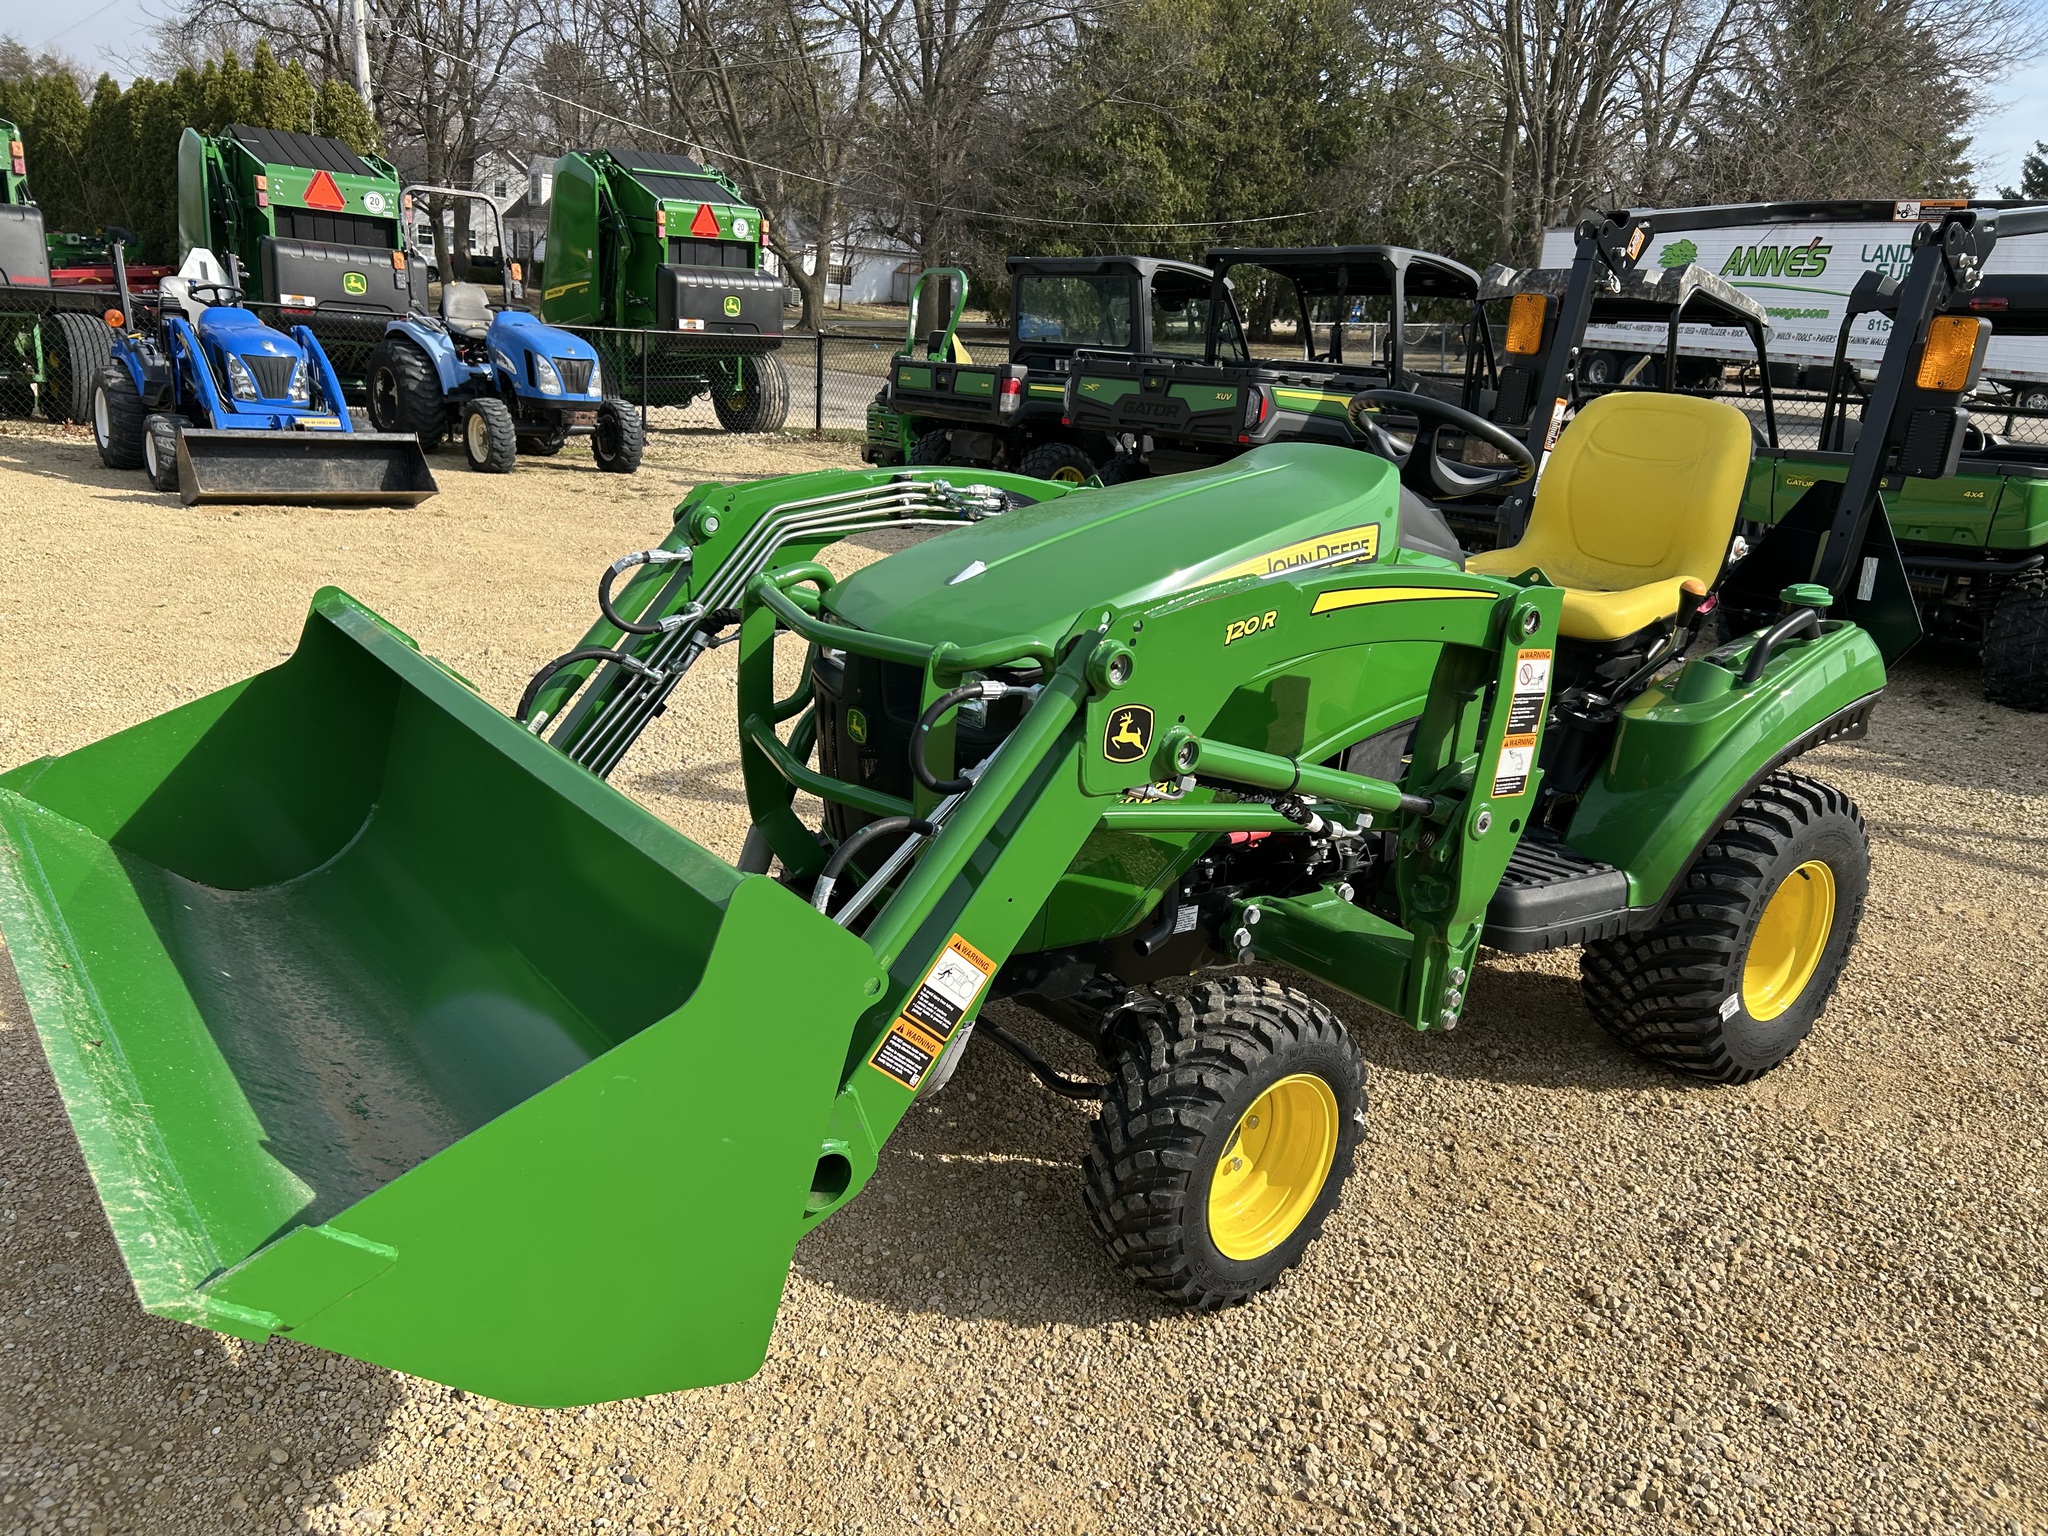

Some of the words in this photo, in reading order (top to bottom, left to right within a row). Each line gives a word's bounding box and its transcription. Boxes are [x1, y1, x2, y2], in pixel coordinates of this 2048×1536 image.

[369, 196, 380, 206] 20
[737, 223, 745, 232] 20
[1794, 333, 1813, 342] TOOLS
[1815, 334, 1836, 344] PAVERS
[1848, 335, 1870, 346] TAINING
[1214, 392, 1233, 401] XUV
[1122, 401, 1181, 418] GATOR
[1786, 478, 1815, 488] GATOR
[1267, 551, 1314, 575] JOHN
[1524, 650, 1551, 660] WARNING
[1509, 737, 1535, 747] WARNING
[960, 943, 990, 971] WARNING
[905, 1028, 937, 1053] WARNING
